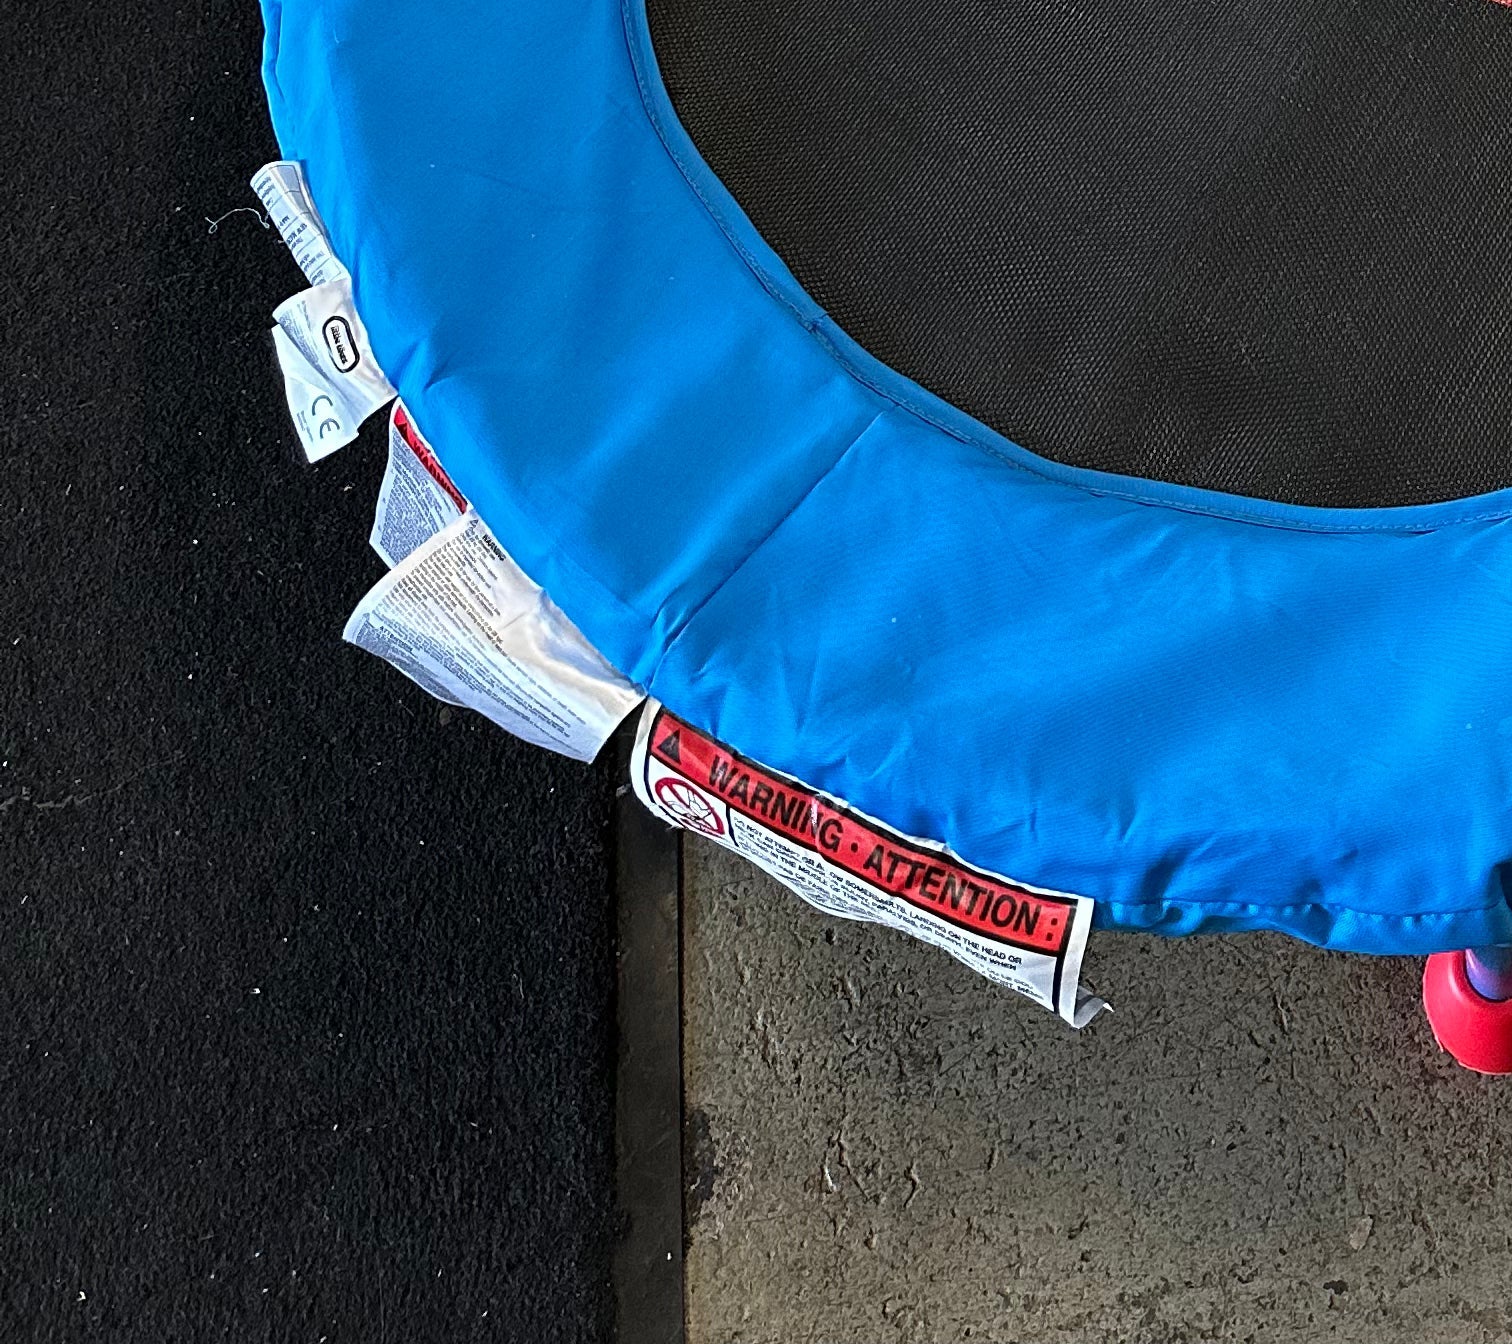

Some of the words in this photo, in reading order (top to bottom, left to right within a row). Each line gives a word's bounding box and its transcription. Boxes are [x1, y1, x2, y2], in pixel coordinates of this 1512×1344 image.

[709, 756, 846, 853] WARNING
[863, 844, 1042, 935] ATTENTION
[982, 945, 1007, 961] HEAD
